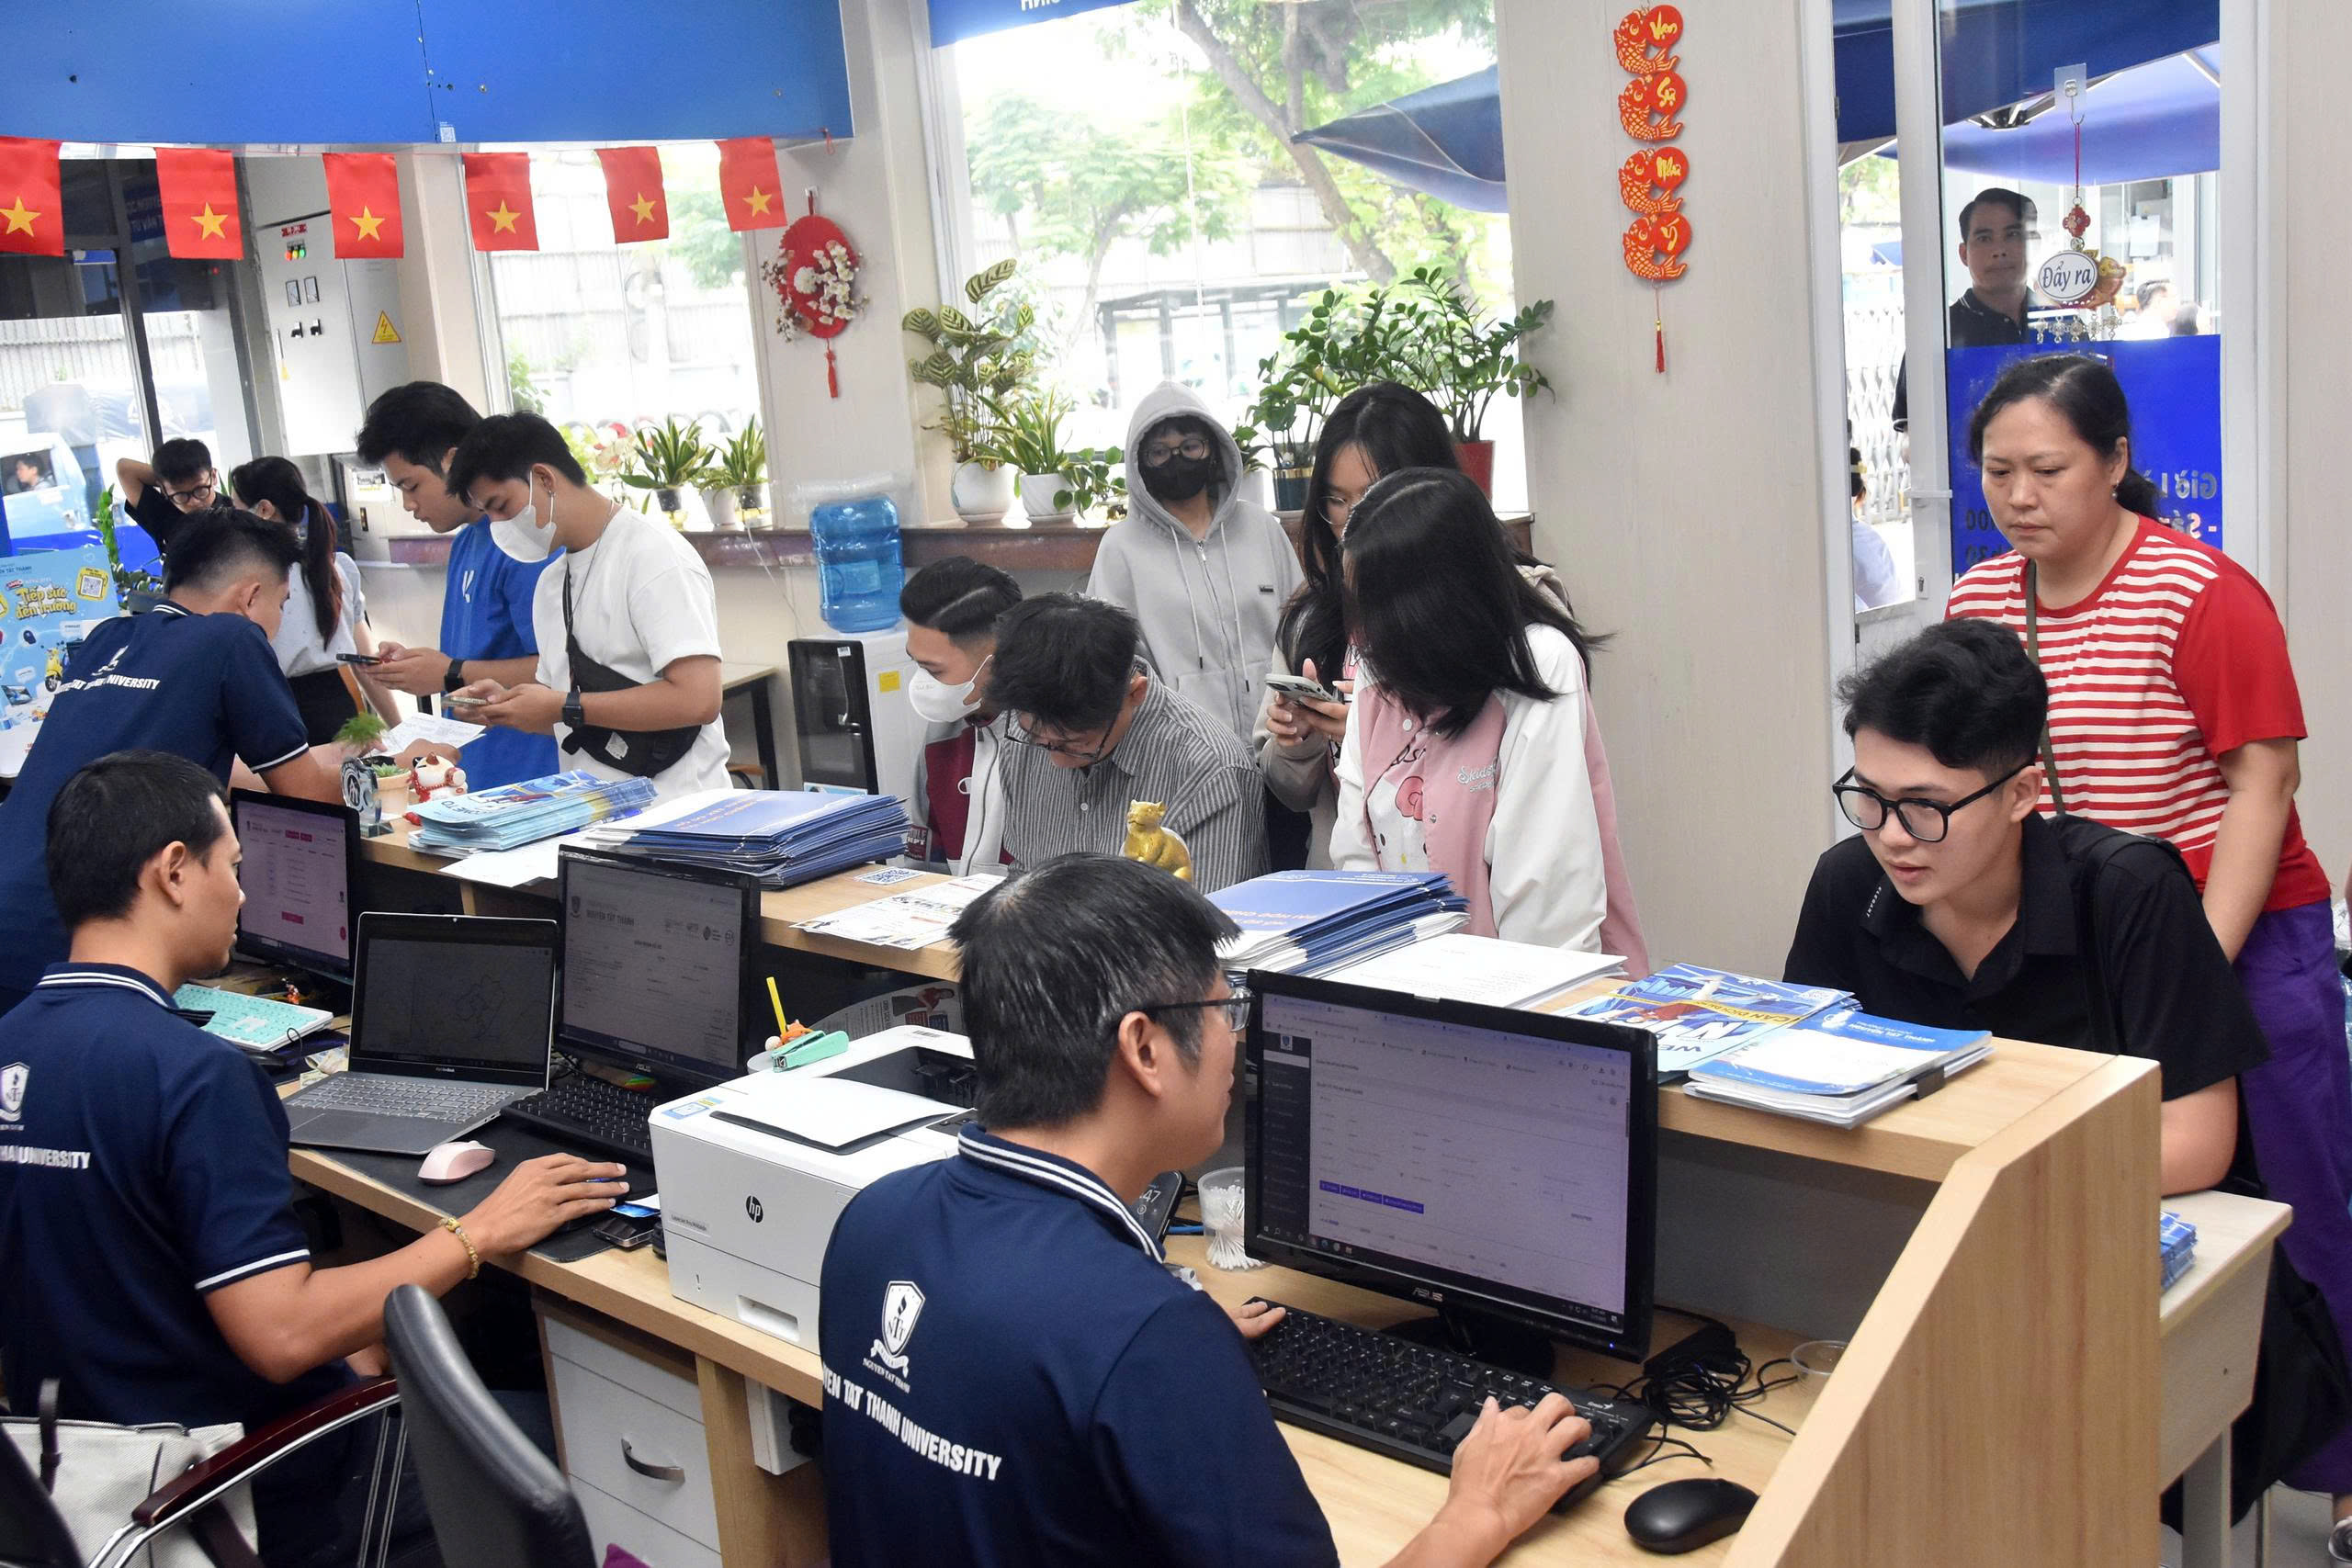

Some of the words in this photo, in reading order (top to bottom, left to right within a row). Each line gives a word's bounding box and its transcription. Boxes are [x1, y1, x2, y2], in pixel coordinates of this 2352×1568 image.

[1660, 218, 1680, 250] Ý
[2042, 260, 2071, 292] Đẩy
[2075, 268, 2091, 286] ra
[15, 587, 45, 604] Tiếp
[104, 674, 161, 690] NIVERSITY
[747, 1195, 762, 1223] hp
[1412, 1287, 1443, 1302] ASUS
[843, 1379, 864, 1411] TAT
[866, 1391, 901, 1437] THANH
[900, 1416, 1002, 1482] UNIVERSITY
